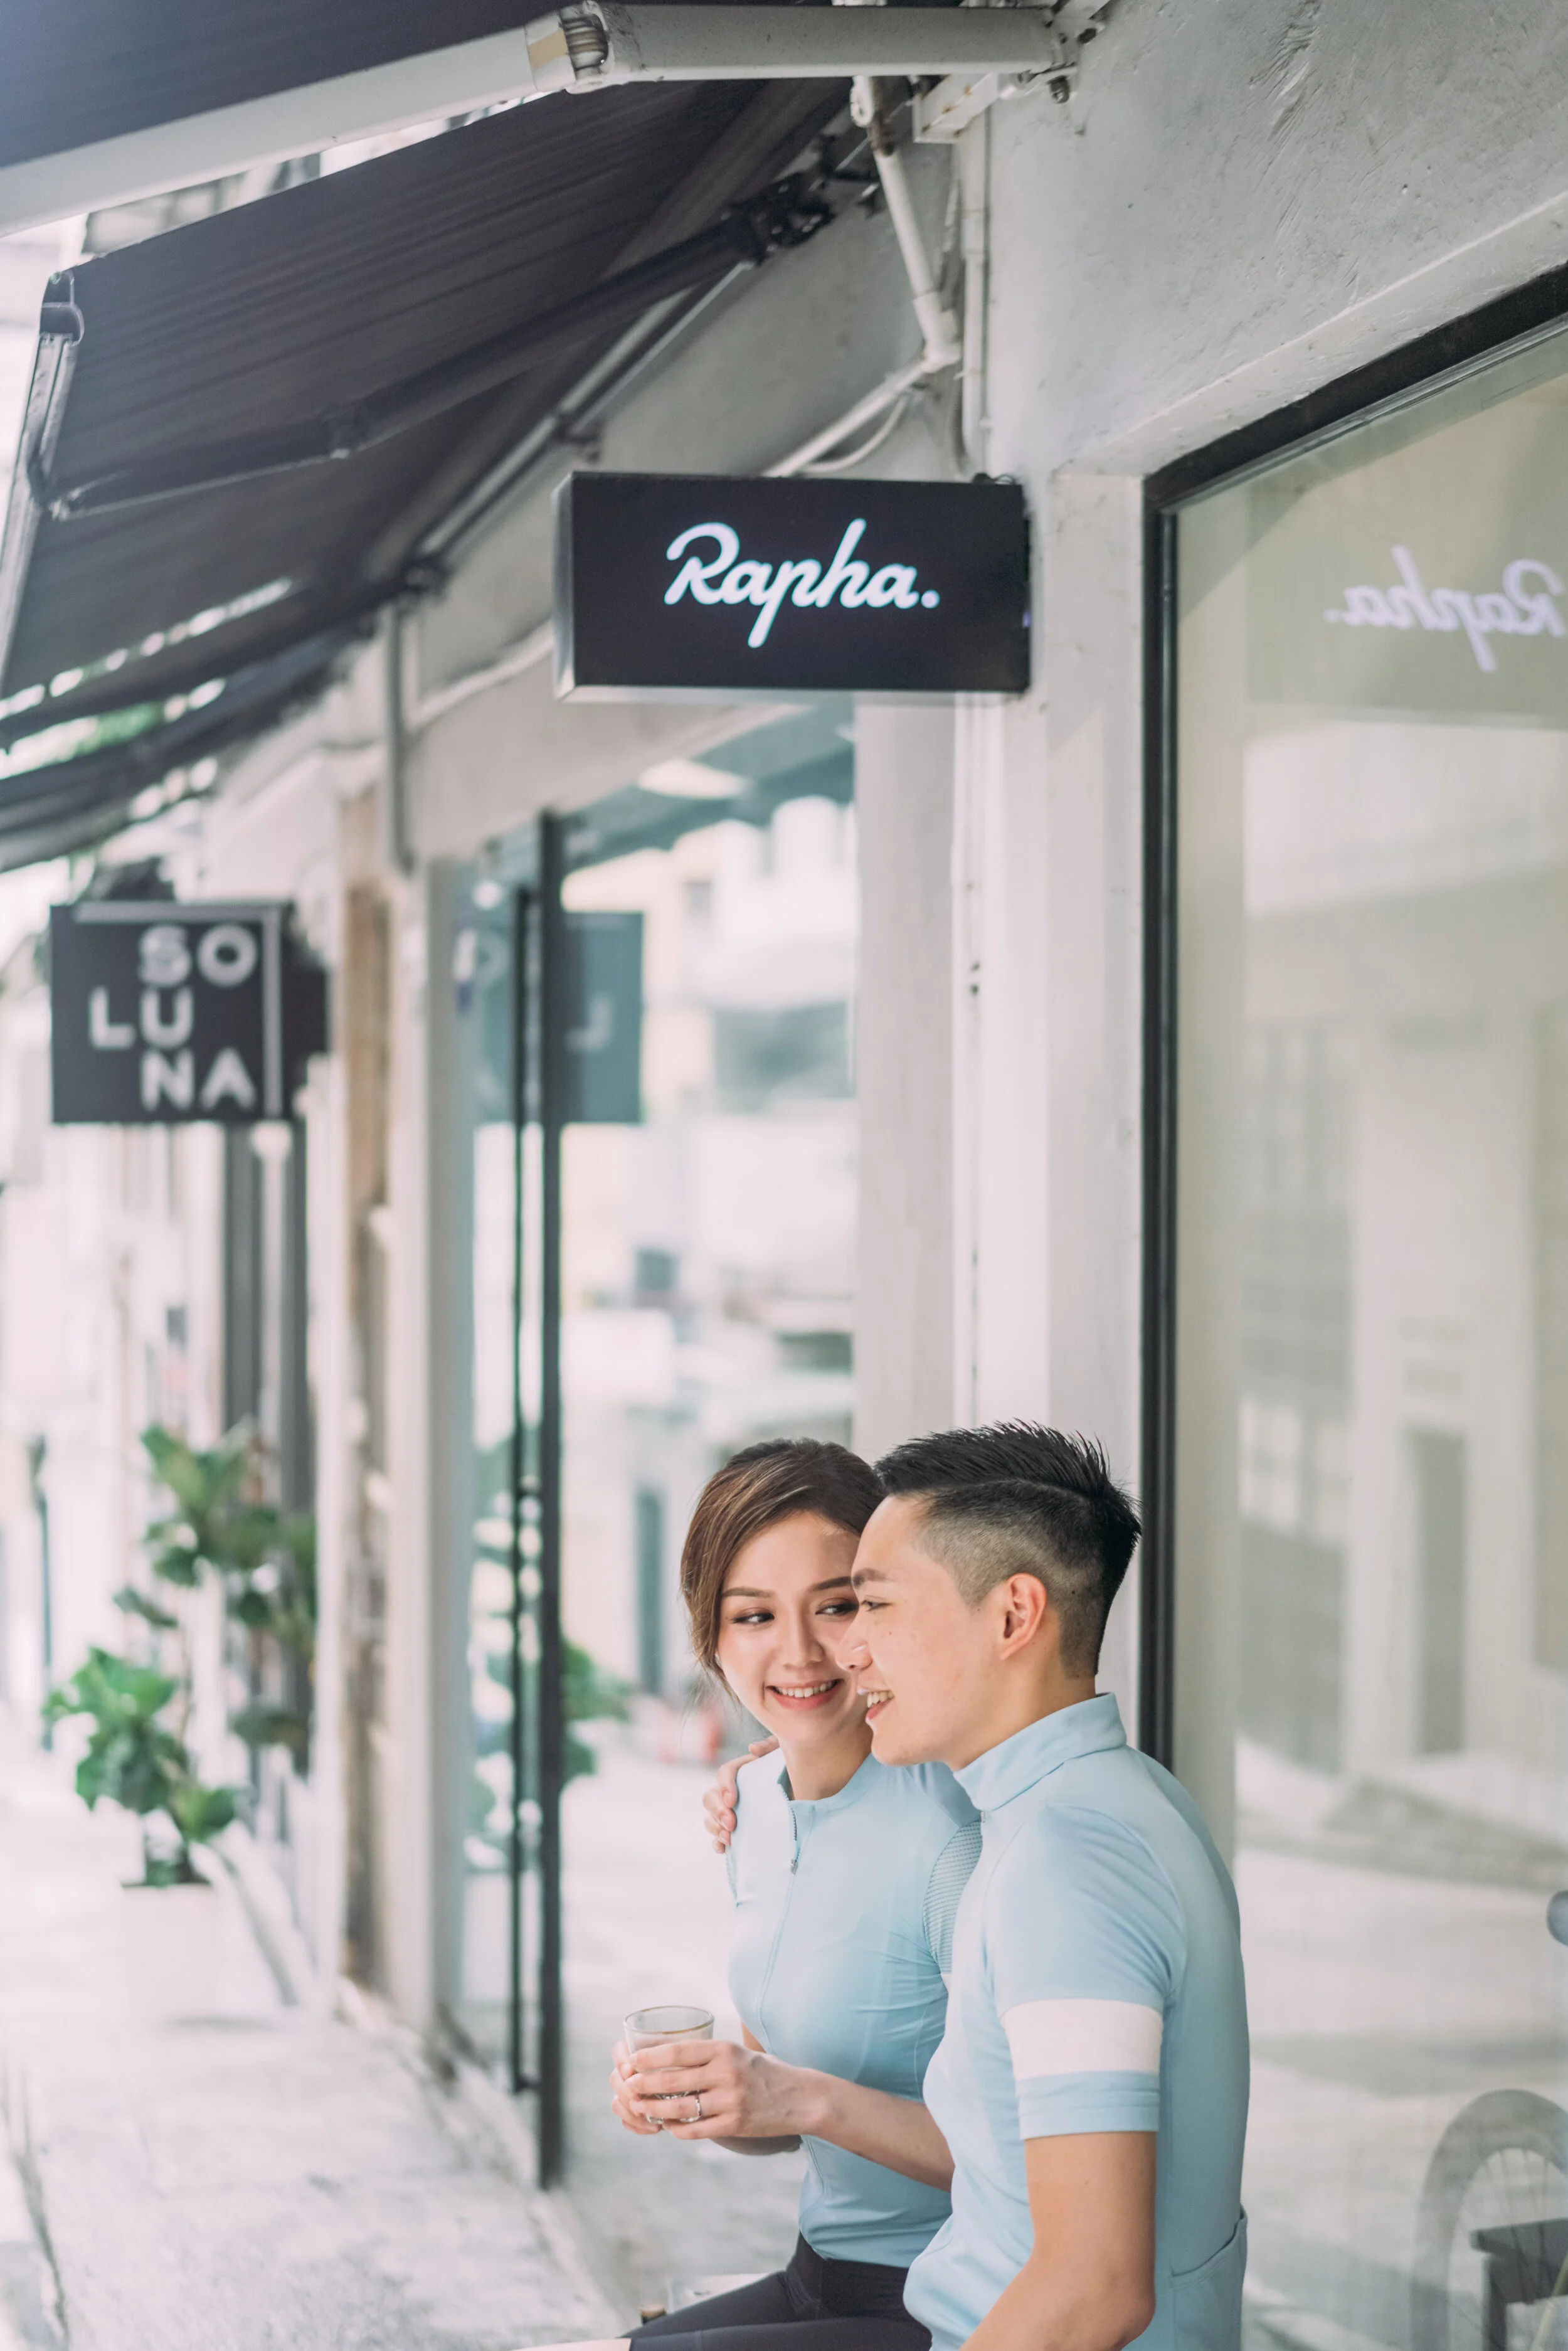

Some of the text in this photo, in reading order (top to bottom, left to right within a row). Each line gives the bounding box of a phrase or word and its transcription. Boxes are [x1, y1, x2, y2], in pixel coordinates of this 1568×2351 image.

[664, 518, 940, 649] Rapha.
[139, 924, 257, 987] SO
[89, 986, 193, 1049] LU
[140, 1048, 255, 1111] NA
